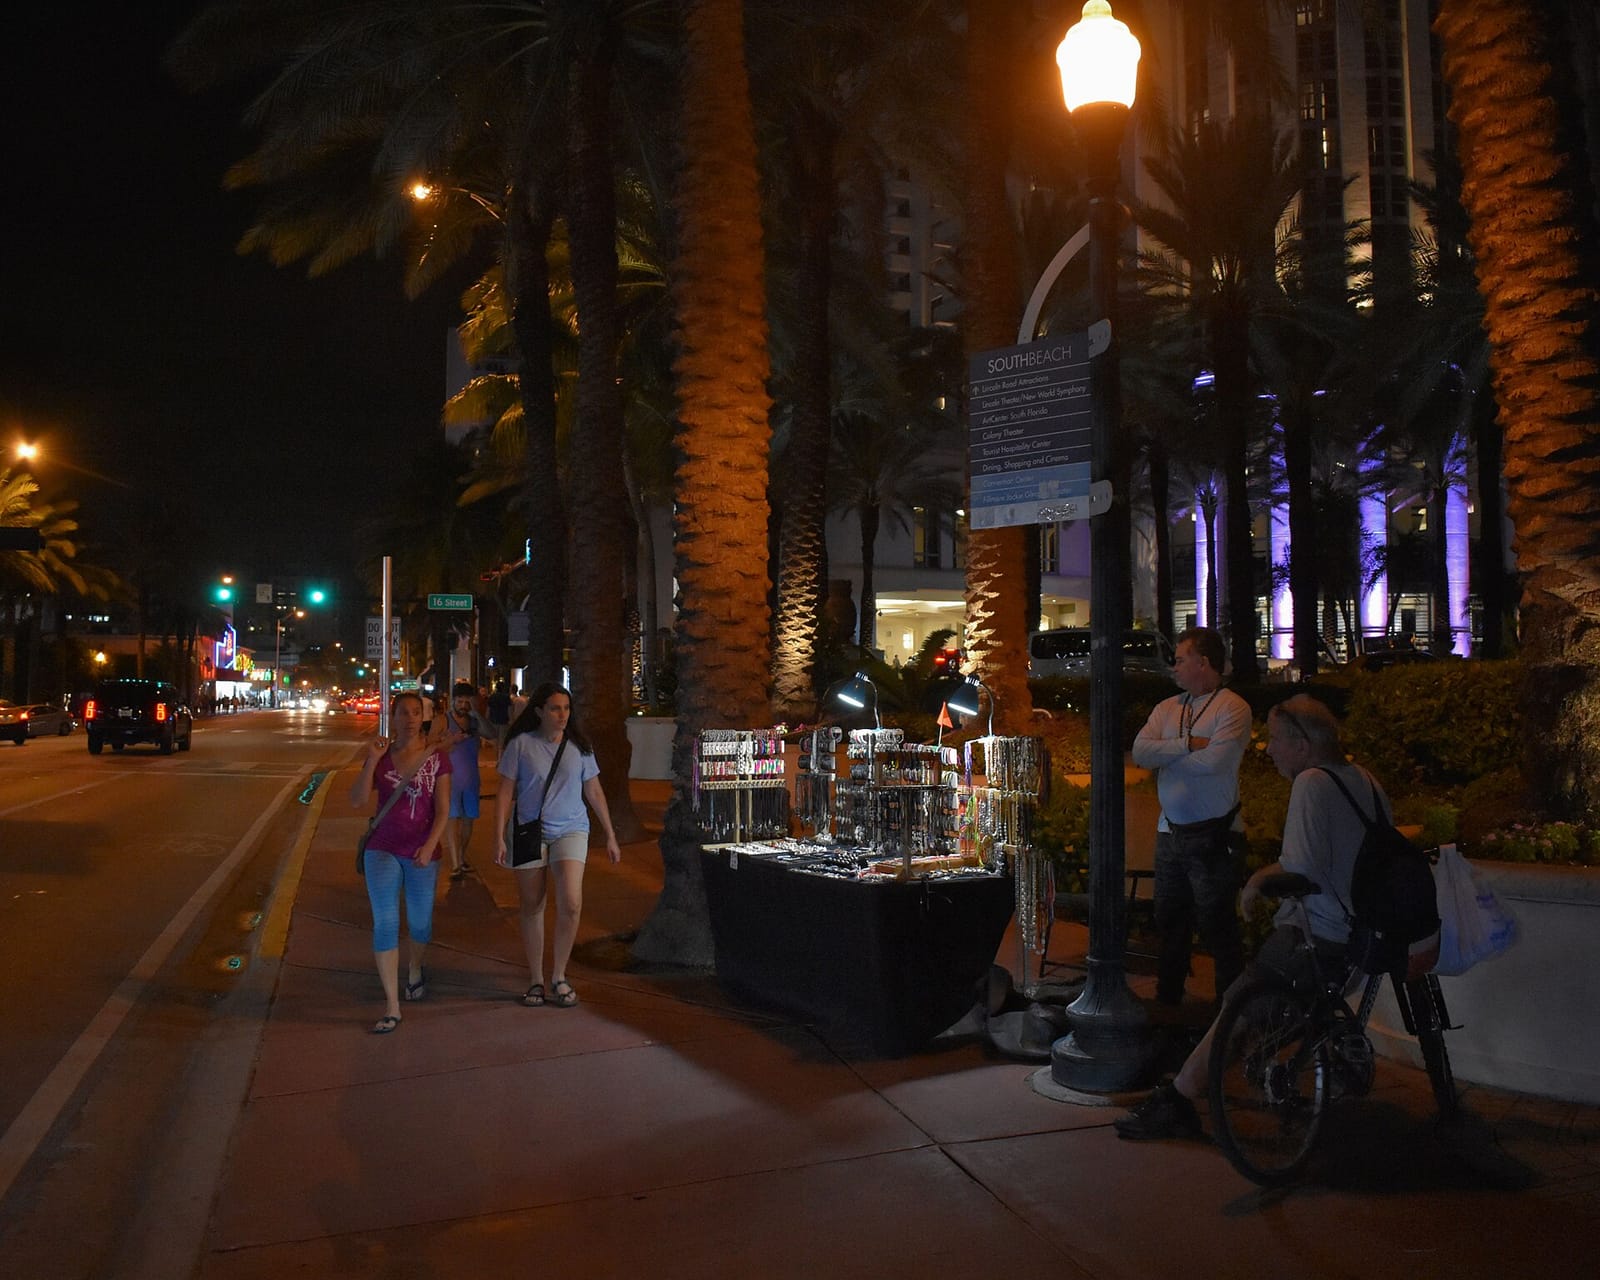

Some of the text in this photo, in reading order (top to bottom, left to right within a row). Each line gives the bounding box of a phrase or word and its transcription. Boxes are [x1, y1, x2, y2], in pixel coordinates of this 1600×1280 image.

[987, 345, 1072, 374] SOUTHBEACH
[982, 375, 1049, 393] Lincoln Road Attractions
[982, 399, 1000, 409] Lincoln
[1038, 389, 1056, 399] World
[1057, 385, 1086, 397] Symphony
[1010, 411, 1026, 421] South
[1027, 406, 1049, 417] Florida
[982, 428, 1024, 441] Colony Theater
[1001, 441, 1031, 454] Hospitality
[1032, 440, 1052, 448] Center
[1004, 458, 1032, 469] Shopping
[1032, 456, 1045, 465] and
[1045, 454, 1069, 463] Cinema
[433, 597, 468, 607] 16 Street
[368, 623, 380, 633] DO
